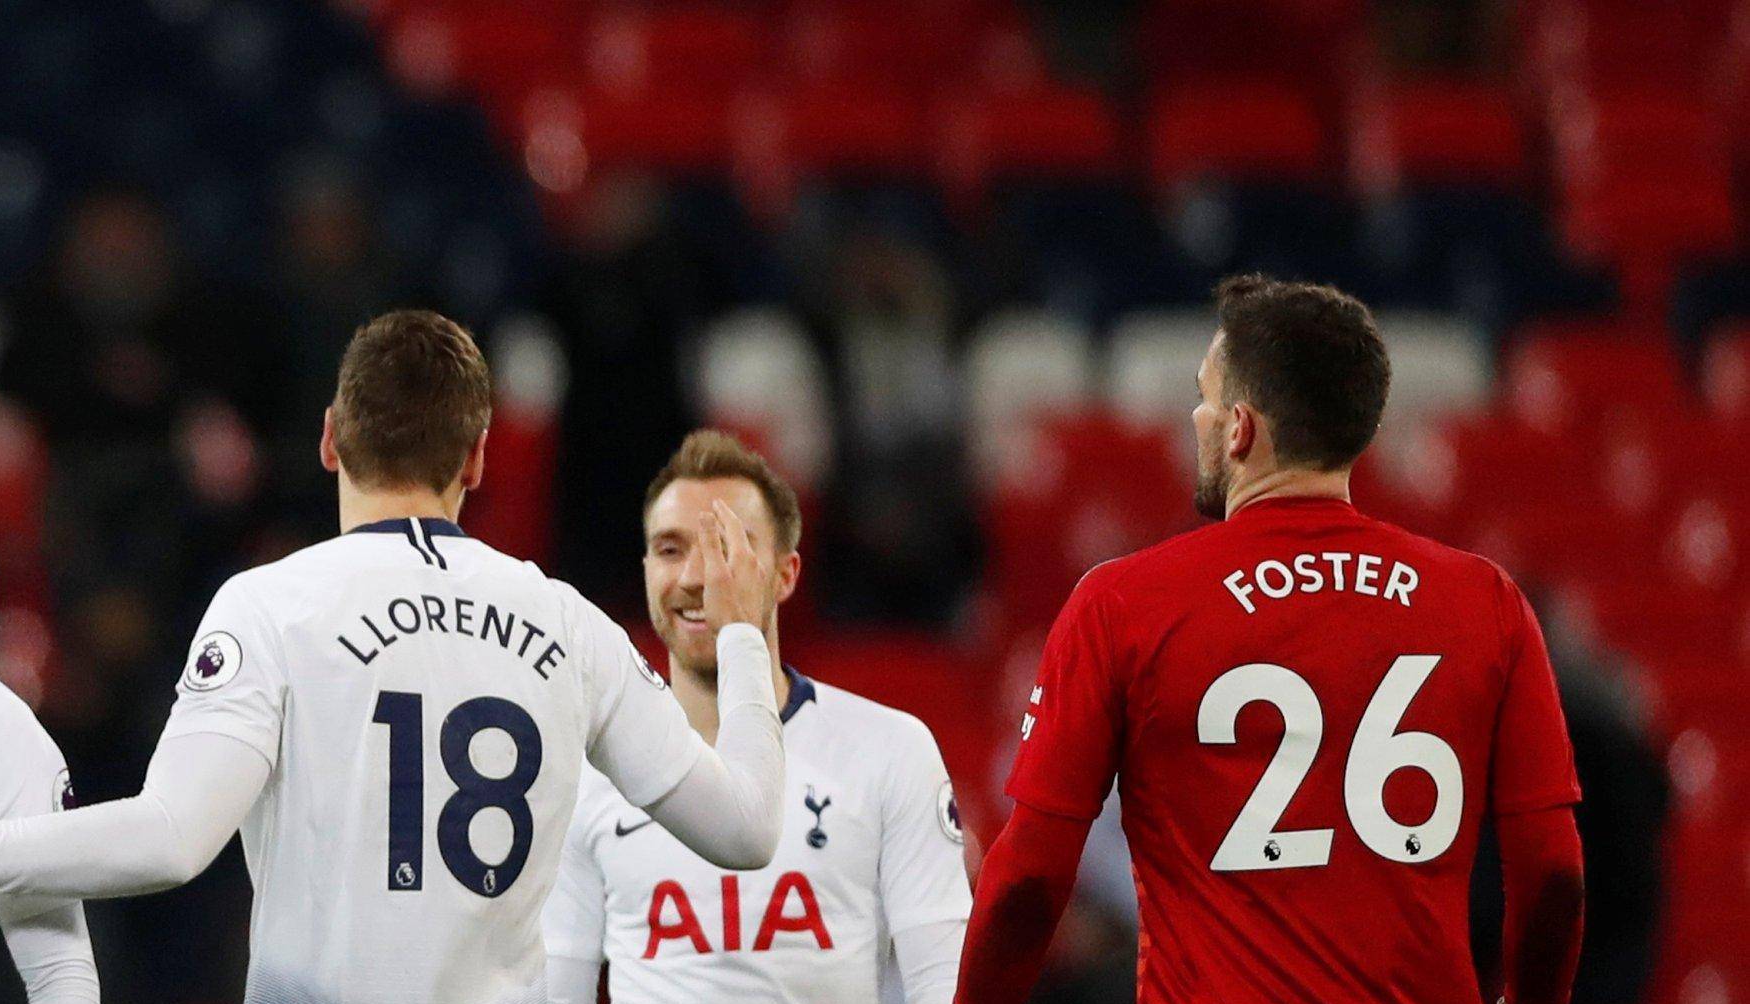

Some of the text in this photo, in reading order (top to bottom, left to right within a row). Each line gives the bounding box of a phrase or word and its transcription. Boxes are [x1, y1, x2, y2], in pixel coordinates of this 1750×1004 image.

[1222, 552, 1420, 614] FOSTER
[337, 595, 567, 680] LLORENTE
[372, 690, 543, 899] 18
[1197, 654, 1464, 871] 26
[641, 871, 834, 960] AIA
